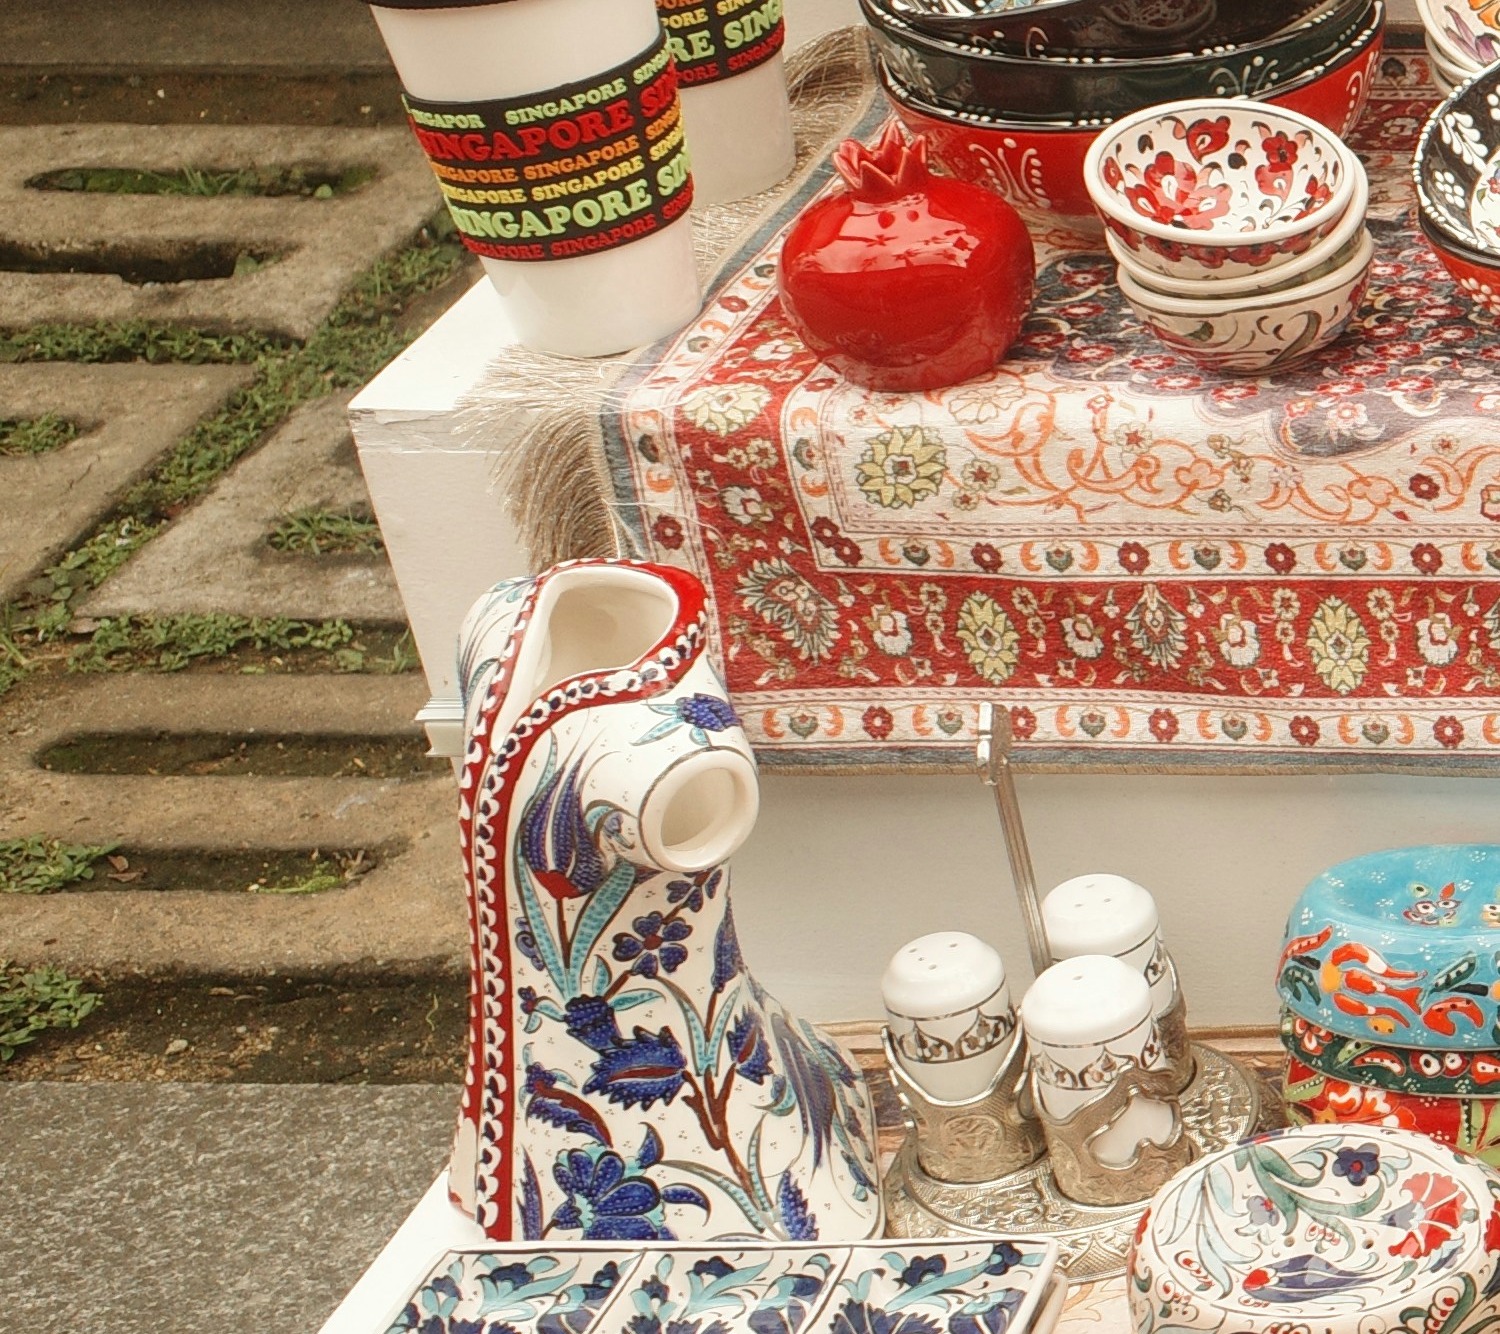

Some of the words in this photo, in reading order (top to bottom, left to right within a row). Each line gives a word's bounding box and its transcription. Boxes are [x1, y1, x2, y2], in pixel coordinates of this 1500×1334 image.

[504, 77, 628, 126] SINGAPORE
[523, 134, 641, 182] SINGAPORE
[531, 155, 645, 203] SINGAPORE
[549, 213, 659, 257] SINGAPORE
